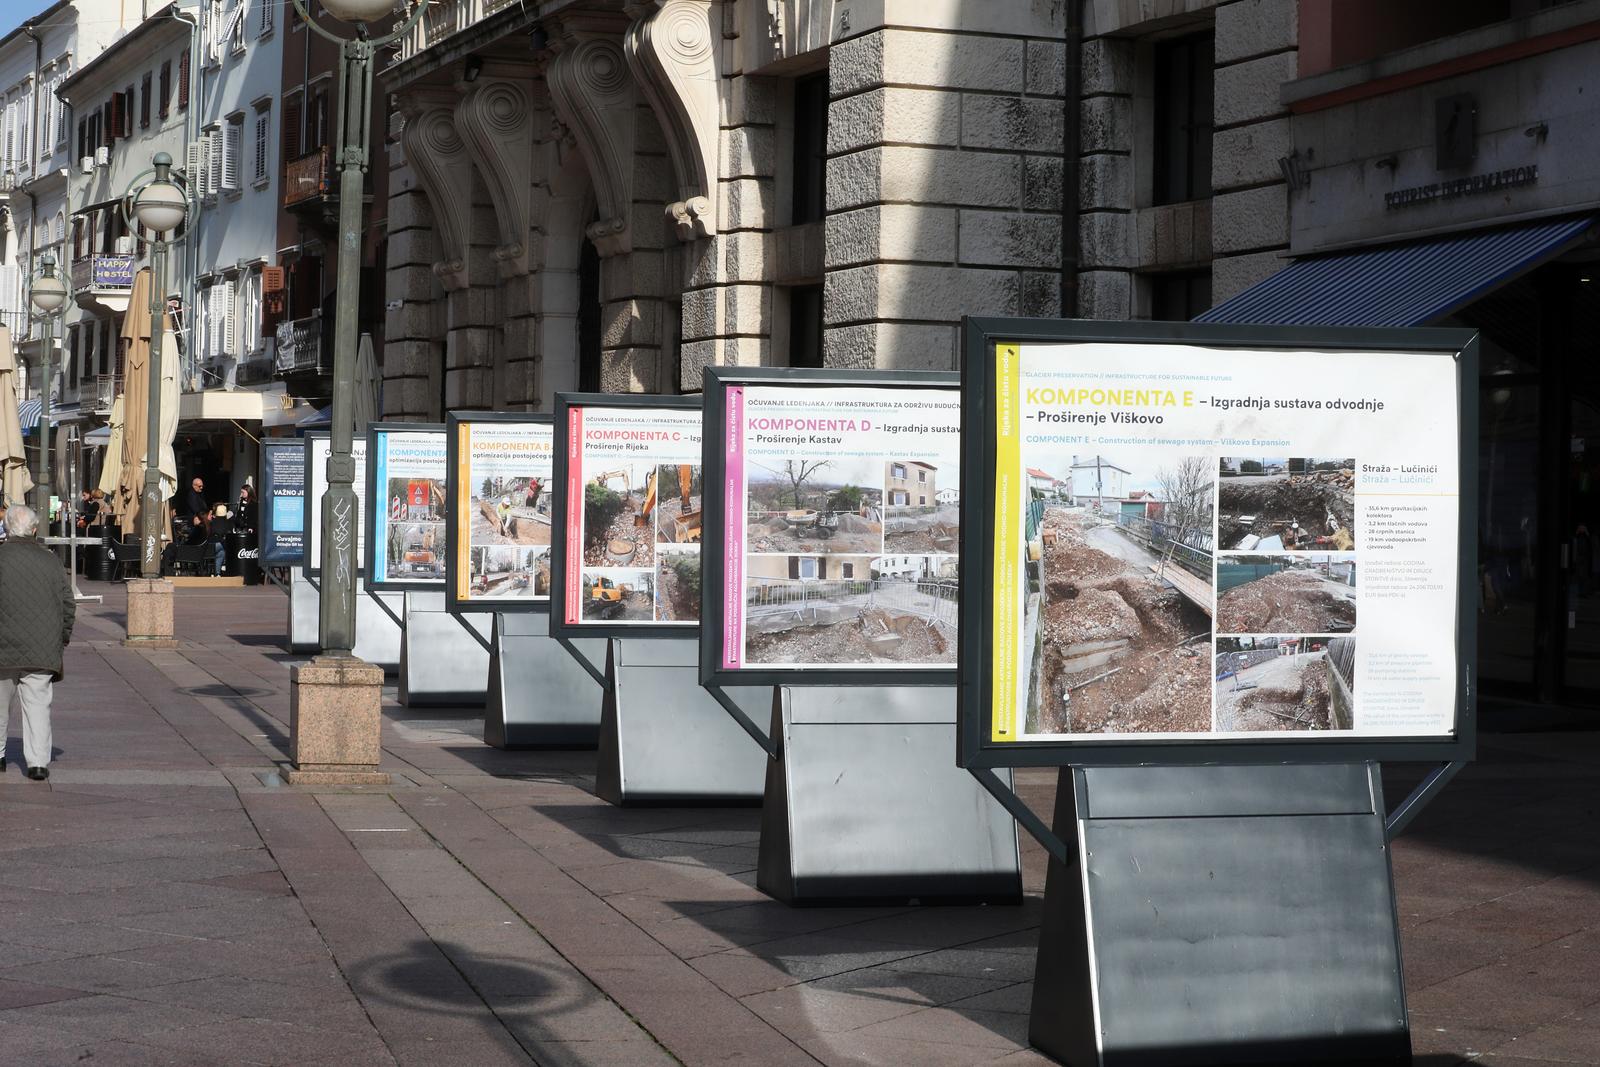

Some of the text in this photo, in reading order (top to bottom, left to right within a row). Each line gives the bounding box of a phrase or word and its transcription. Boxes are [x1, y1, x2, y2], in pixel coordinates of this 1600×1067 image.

[1384, 165, 1538, 209] TOURIST INFORMATION
[1026, 388, 1176, 406] KOMPONENTA
[1182, 391, 1194, 406] E
[1211, 396, 1270, 410] Izgradnja
[1274, 397, 1322, 409] sustava
[1325, 398, 1384, 412] odvodnje
[1038, 410, 1106, 426] Proširenje
[1110, 411, 1164, 424] Viškovo
[748, 418, 856, 432] KOMPONENTA
[861, 420, 871, 431] D
[883, 424, 929, 435] Izgradnja
[586, 430, 669, 440] KOMPONENTA
[672, 432, 681, 441] C
[757, 434, 806, 446] Proširenje
[809, 436, 842, 444] Kastav
[1026, 435, 1082, 444] COMPONENT
[1084, 436, 1090, 444] E
[1098, 436, 1147, 445] Construction
[1149, 436, 1156, 445] of
[1157, 439, 1186, 447] sewage
[1187, 439, 1213, 447] system
[1220, 438, 1250, 446] Viškovo
[1251, 438, 1290, 448] Expansion
[473, 442, 541, 450] KOMPONENTA
[586, 442, 649, 451] Proširenje Rijeka
[1362, 464, 1391, 473] Straža
[1401, 464, 1438, 473] Lučinići
[1362, 474, 1389, 484] Straža
